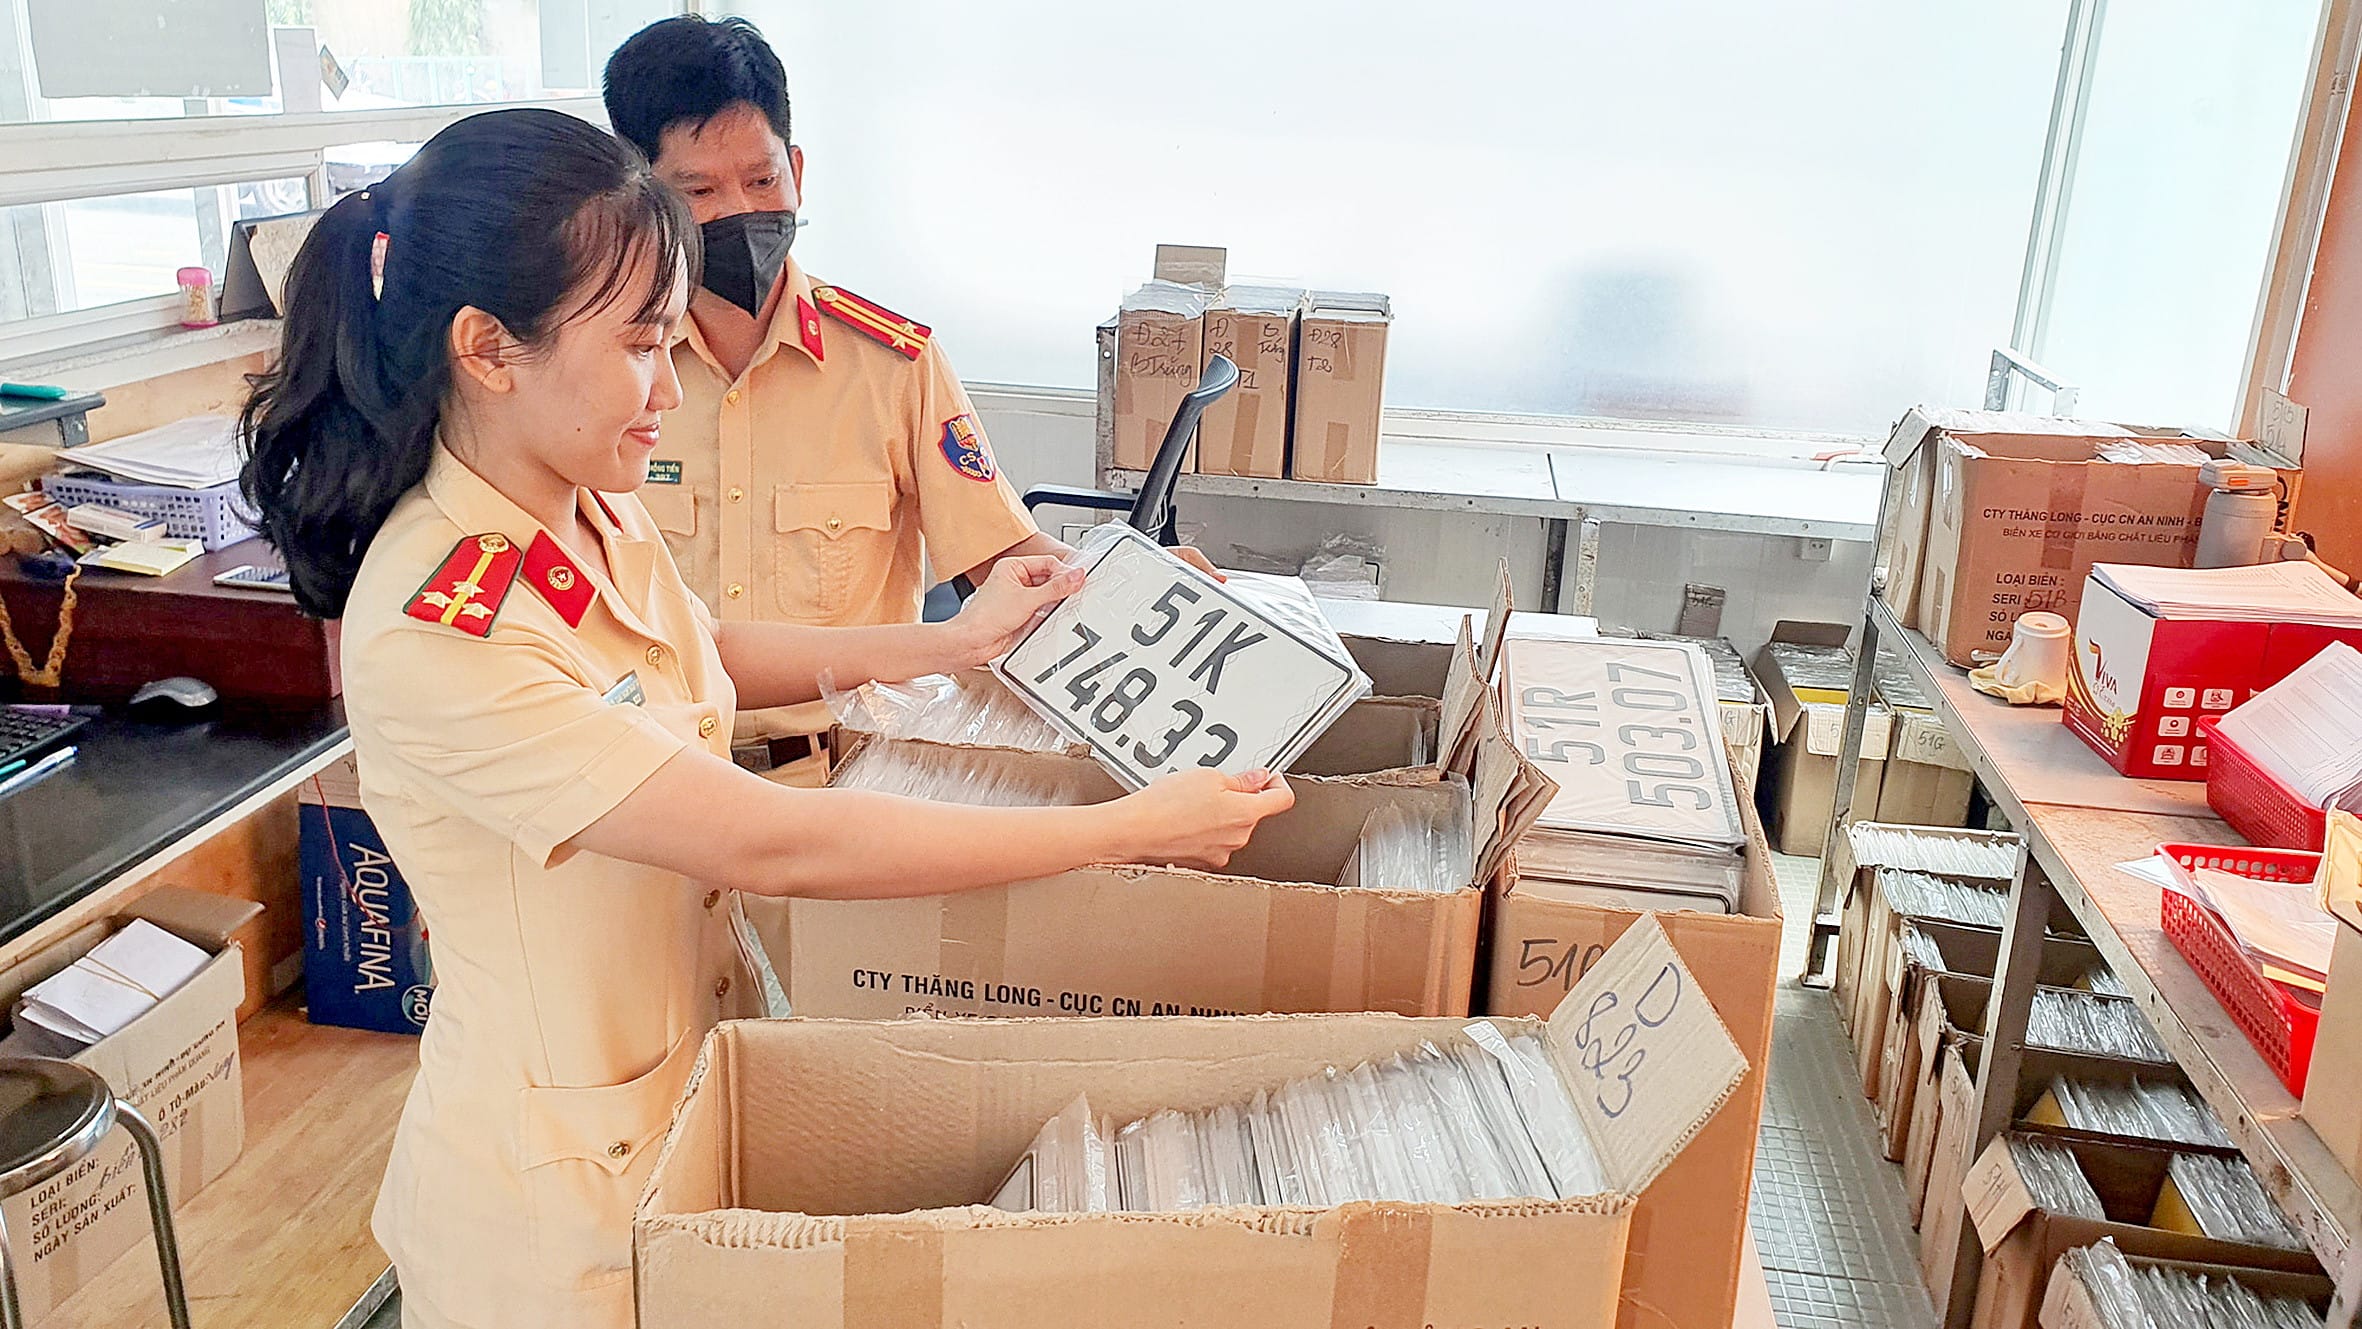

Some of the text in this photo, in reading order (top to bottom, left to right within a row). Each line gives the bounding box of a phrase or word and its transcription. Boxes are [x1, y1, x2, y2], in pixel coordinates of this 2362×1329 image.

[1983, 508, 2006, 519] CTY
[2050, 511, 2082, 523] LONG
[2091, 513, 2116, 526] CỤC
[2118, 514, 2135, 525] CN
[2137, 515, 2154, 525] AN
[2156, 516, 2184, 526] NINH
[2028, 530, 2042, 538] XE
[1996, 573, 2025, 587] LOẠI
[1991, 593, 2021, 605] SERI
[1988, 608, 2007, 622] SỐ
[1130, 581, 1268, 695] 51K
[1522, 687, 1606, 765] 51R
[1606, 663, 1713, 811] 503.07
[349, 842, 396, 994] AQUAFINA
[852, 969, 893, 991] CTY
[901, 973, 974, 1000] THĂNG
[984, 983, 1041, 1008] LONG
[1060, 991, 1101, 1015] CỤC
[1111, 997, 1141, 1017] CN
[30, 1180, 60, 1209] LOẠI
[31, 1198, 67, 1228] SERI:
